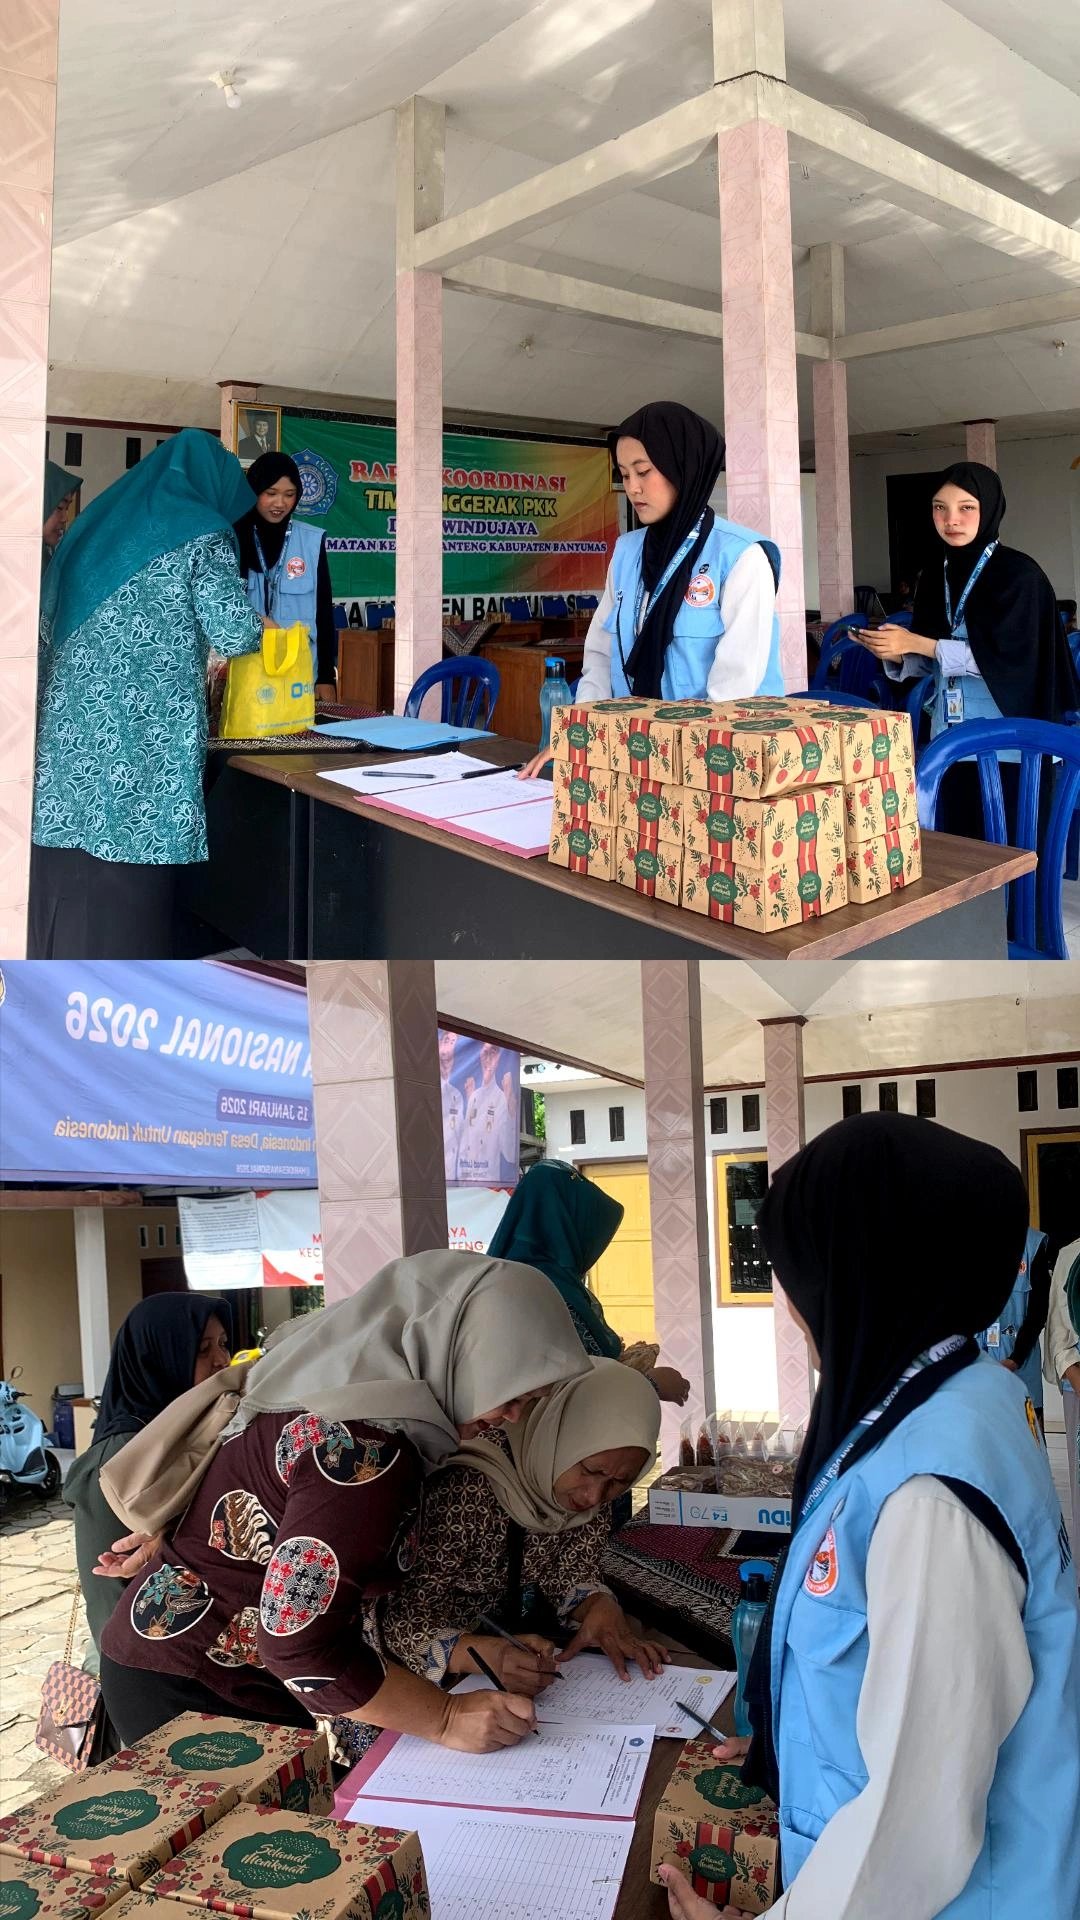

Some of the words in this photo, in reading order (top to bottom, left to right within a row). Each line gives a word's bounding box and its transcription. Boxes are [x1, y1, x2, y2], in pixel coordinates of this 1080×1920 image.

[350, 461, 397, 483] RAP
[442, 468, 567, 492] KOORDINASI
[365, 489, 396, 510] TIM
[442, 495, 520, 516] GGERAK
[523, 499, 557, 517] PKK
[442, 519, 539, 536] WINDUJAYA
[327, 539, 376, 551] MATAN
[490, 542, 551, 552] KABUPATEN
[554, 543, 607, 553] BANYUMAS
[712, 1511, 728, 1522] F4
[758, 1509, 791, 1527] iDU
[255, 1844, 312, 1863] Selamat
